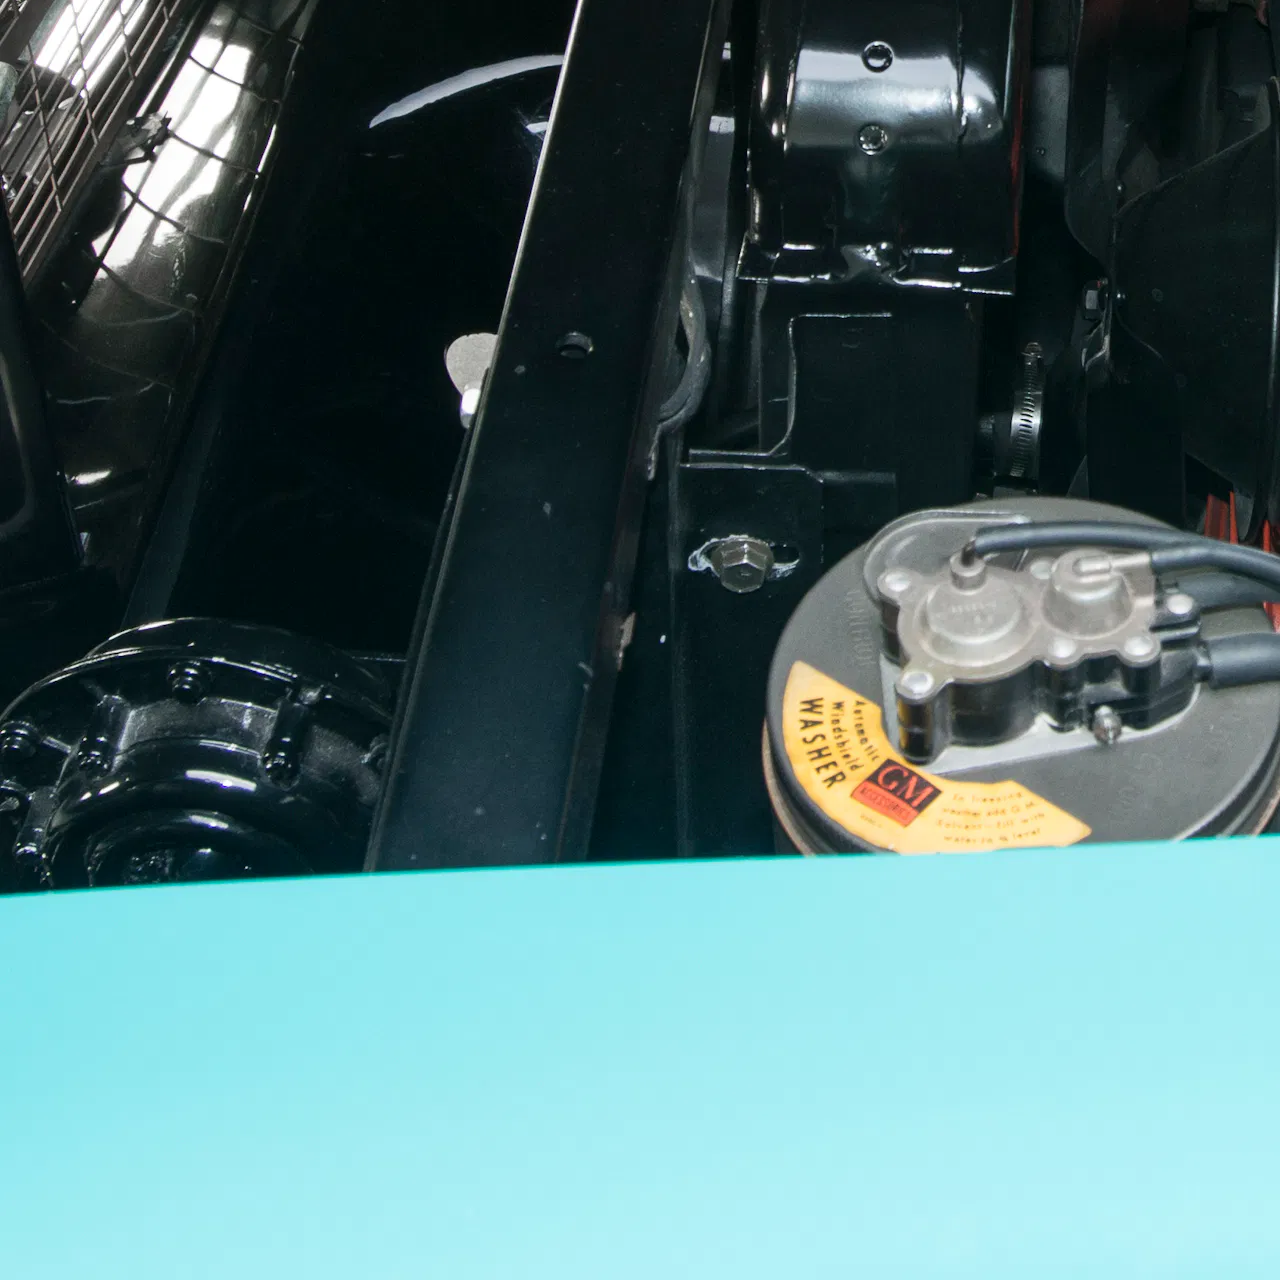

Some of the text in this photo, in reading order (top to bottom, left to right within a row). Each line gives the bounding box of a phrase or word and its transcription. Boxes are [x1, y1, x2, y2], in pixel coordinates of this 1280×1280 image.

[799, 696, 847, 790] WASHER
[831, 700, 865, 772] Windshield
[853, 699, 881, 763] Automatic
[877, 765, 934, 808] GM
